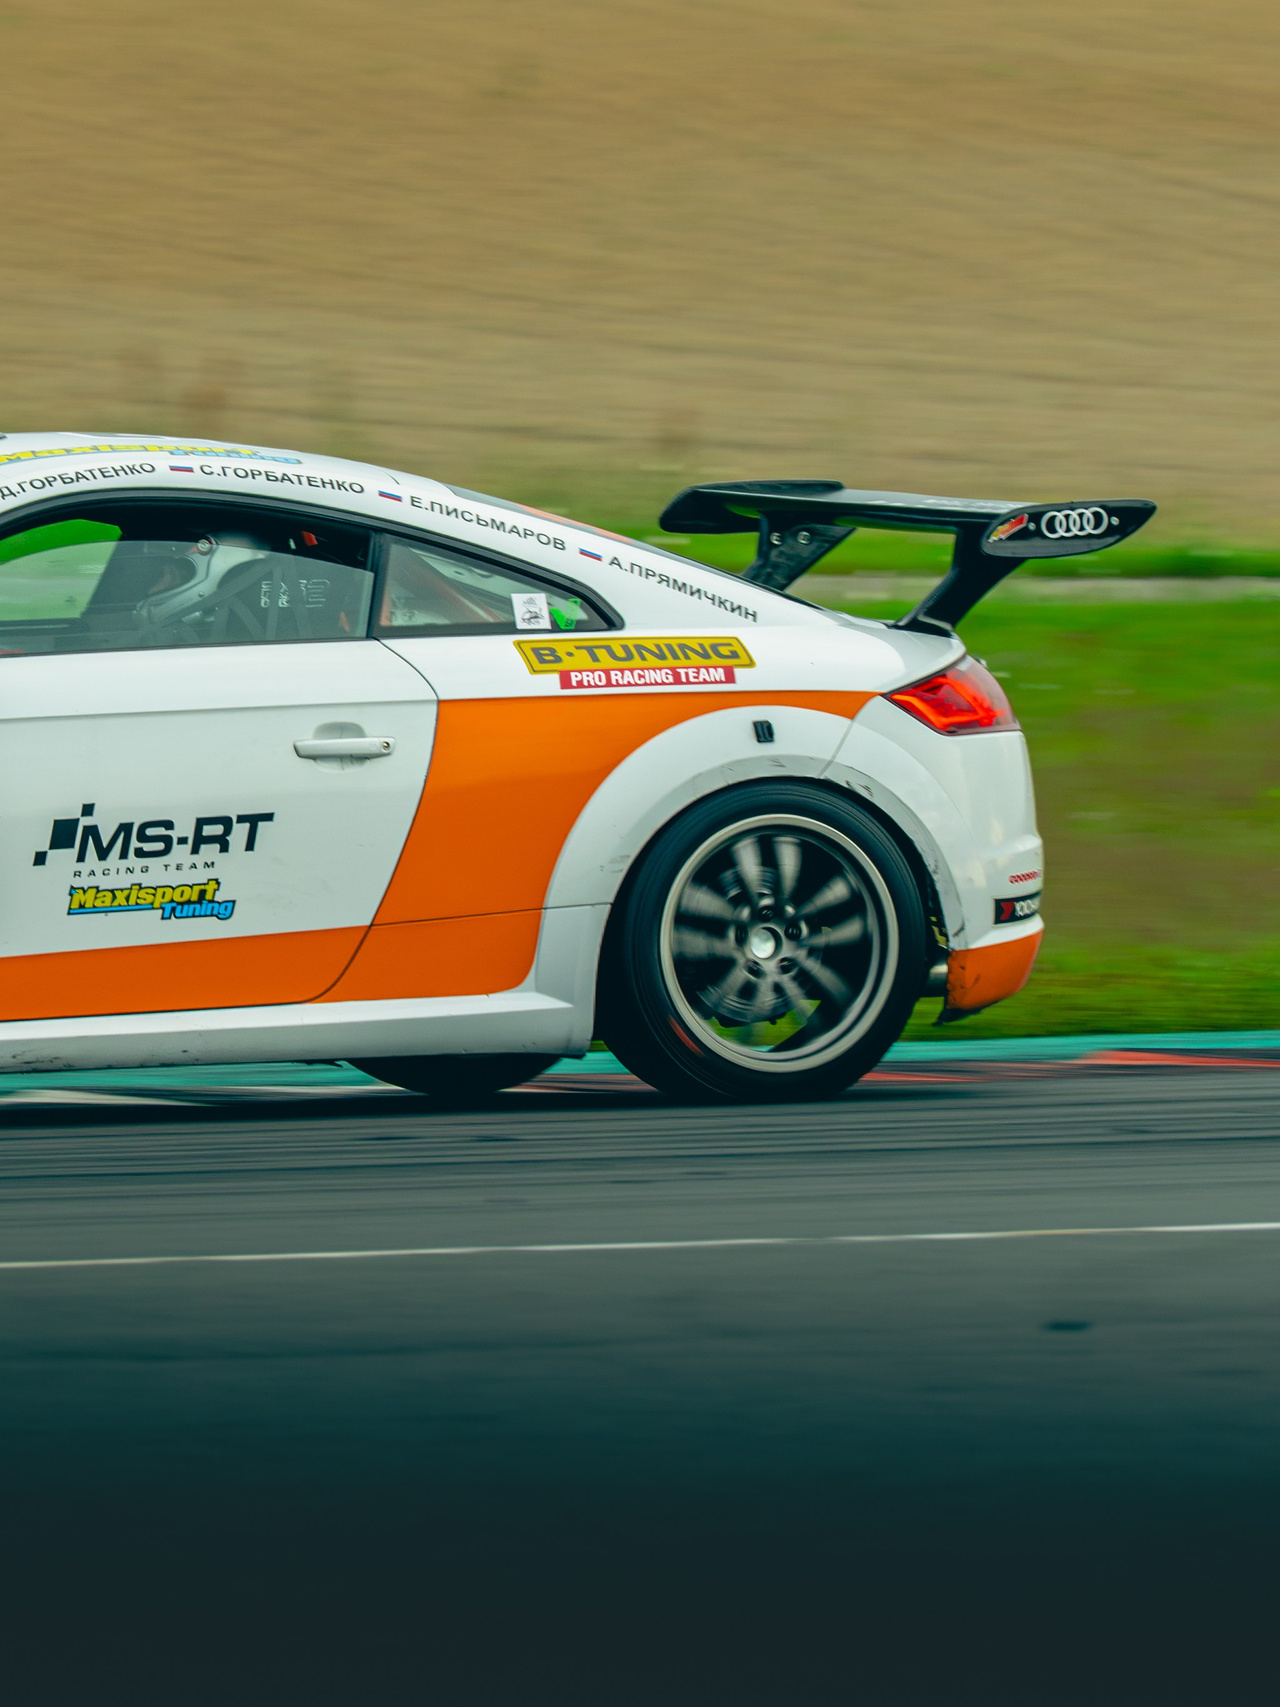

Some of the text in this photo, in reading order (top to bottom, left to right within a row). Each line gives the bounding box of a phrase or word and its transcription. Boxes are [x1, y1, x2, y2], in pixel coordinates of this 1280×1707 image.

[200, 465, 365, 494] С.ГОРБАТЕНКО
[410, 495, 567, 551] Е.ПИСЬМАРОВ
[608, 556, 759, 623] А.ПРЯМИЧКИН
[570, 667, 726, 687] PRO RACING TEAM
[76, 812, 276, 863] MS-RT
[73, 861, 216, 878] RACING TEAM
[68, 878, 220, 910] Maxisport
[160, 900, 236, 920] Tuning
